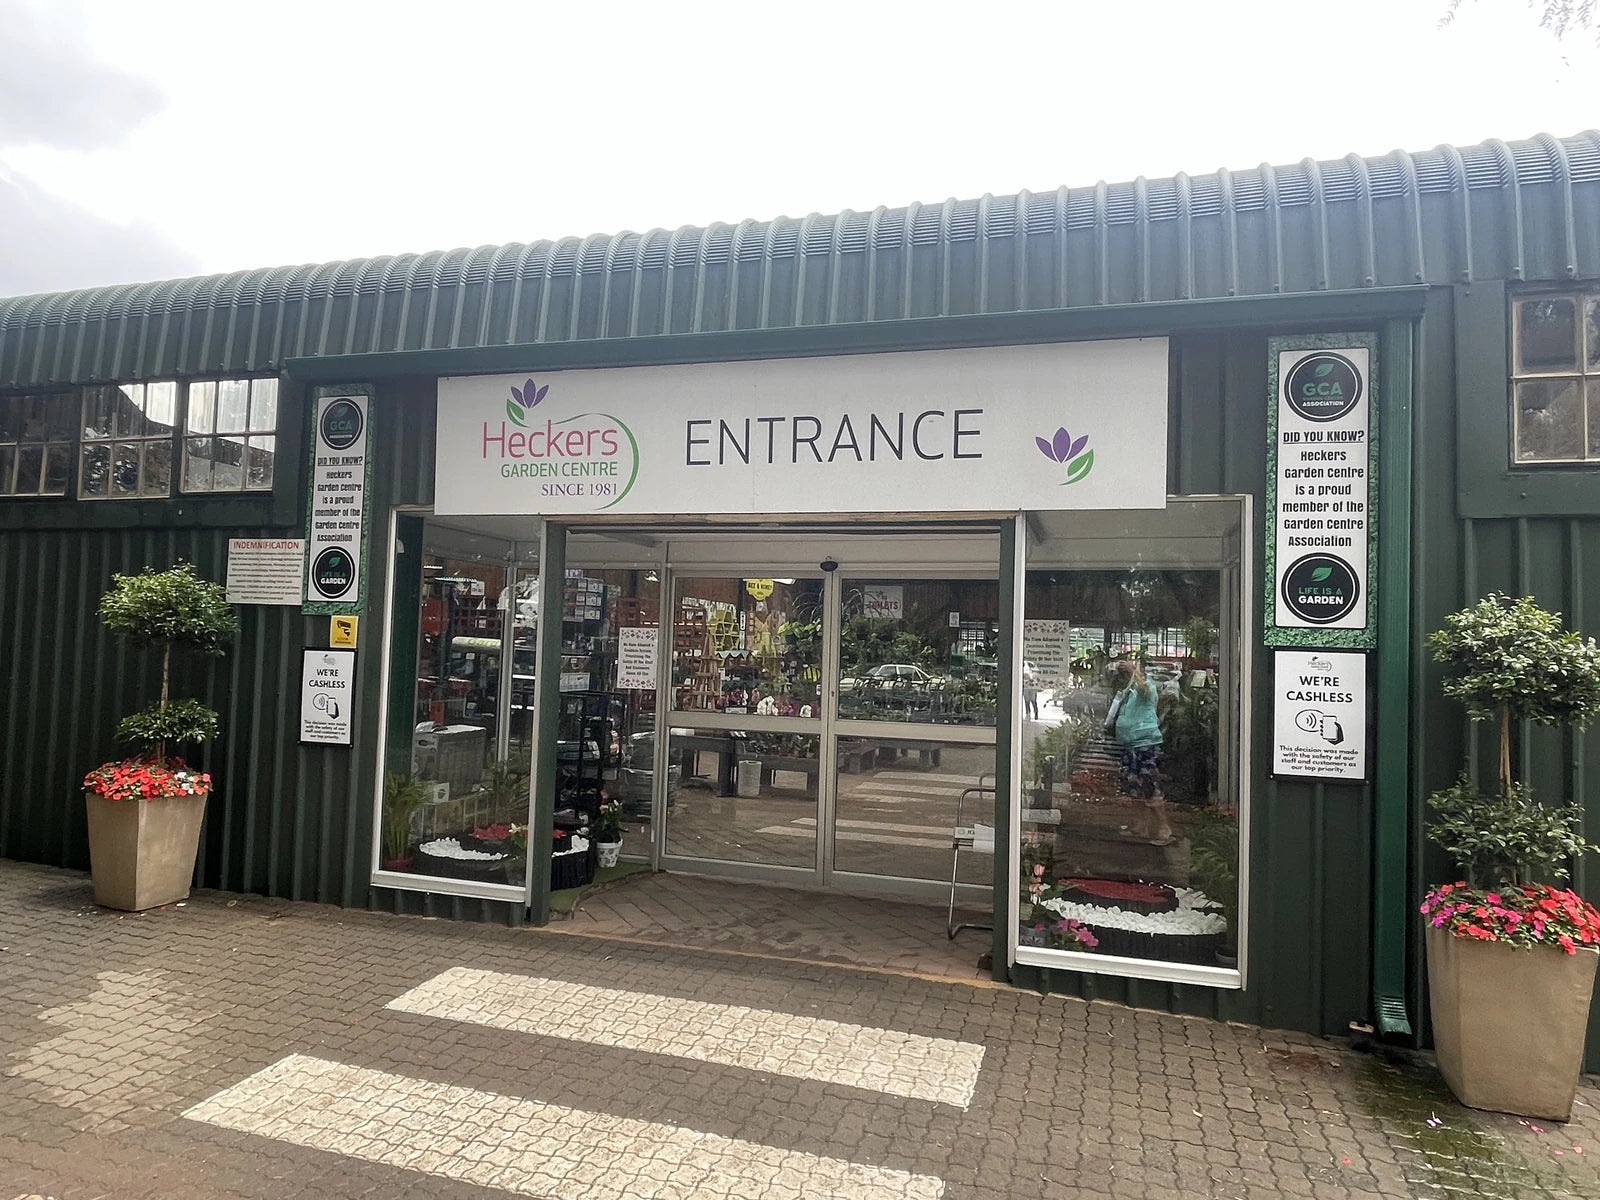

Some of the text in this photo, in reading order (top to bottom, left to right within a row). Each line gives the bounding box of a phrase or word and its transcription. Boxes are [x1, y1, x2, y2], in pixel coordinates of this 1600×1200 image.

[1302, 381, 1343, 396] GCA
[482, 419, 618, 459] Heckers
[685, 408, 984, 466] ENTRANCE
[1283, 430, 1365, 443] DID YOU KNOW?
[317, 455, 363, 465] DID YOU KNOW?
[1300, 449, 1347, 462] Heckers
[500, 461, 618, 478] GARDEN CENTRE
[1284, 466, 1324, 479] Garden
[541, 482, 618, 497] SINCE 1981
[1295, 484, 1352, 497] is a proud
[329, 496, 334, 504] a
[334, 495, 354, 505] proud
[1282, 501, 1364, 512] member of the
[315, 508, 360, 517] member of the
[1283, 519, 1324, 530] Garden
[316, 533, 353, 542] Association
[1288, 535, 1352, 547] Association
[233, 541, 299, 550] INDEMNIFICATION
[320, 577, 346, 585] GARDEN
[1298, 587, 1343, 595] LIFE IS A
[1298, 595, 1344, 605] GARDEN
[316, 668, 339, 677] WE'RE
[308, 679, 346, 689] CASHLESS
[1299, 675, 1340, 687] WE'RE
[1286, 690, 1353, 703] CASHLESS
[1279, 744, 1293, 752] This
[1317, 766, 1346, 774] priority.
